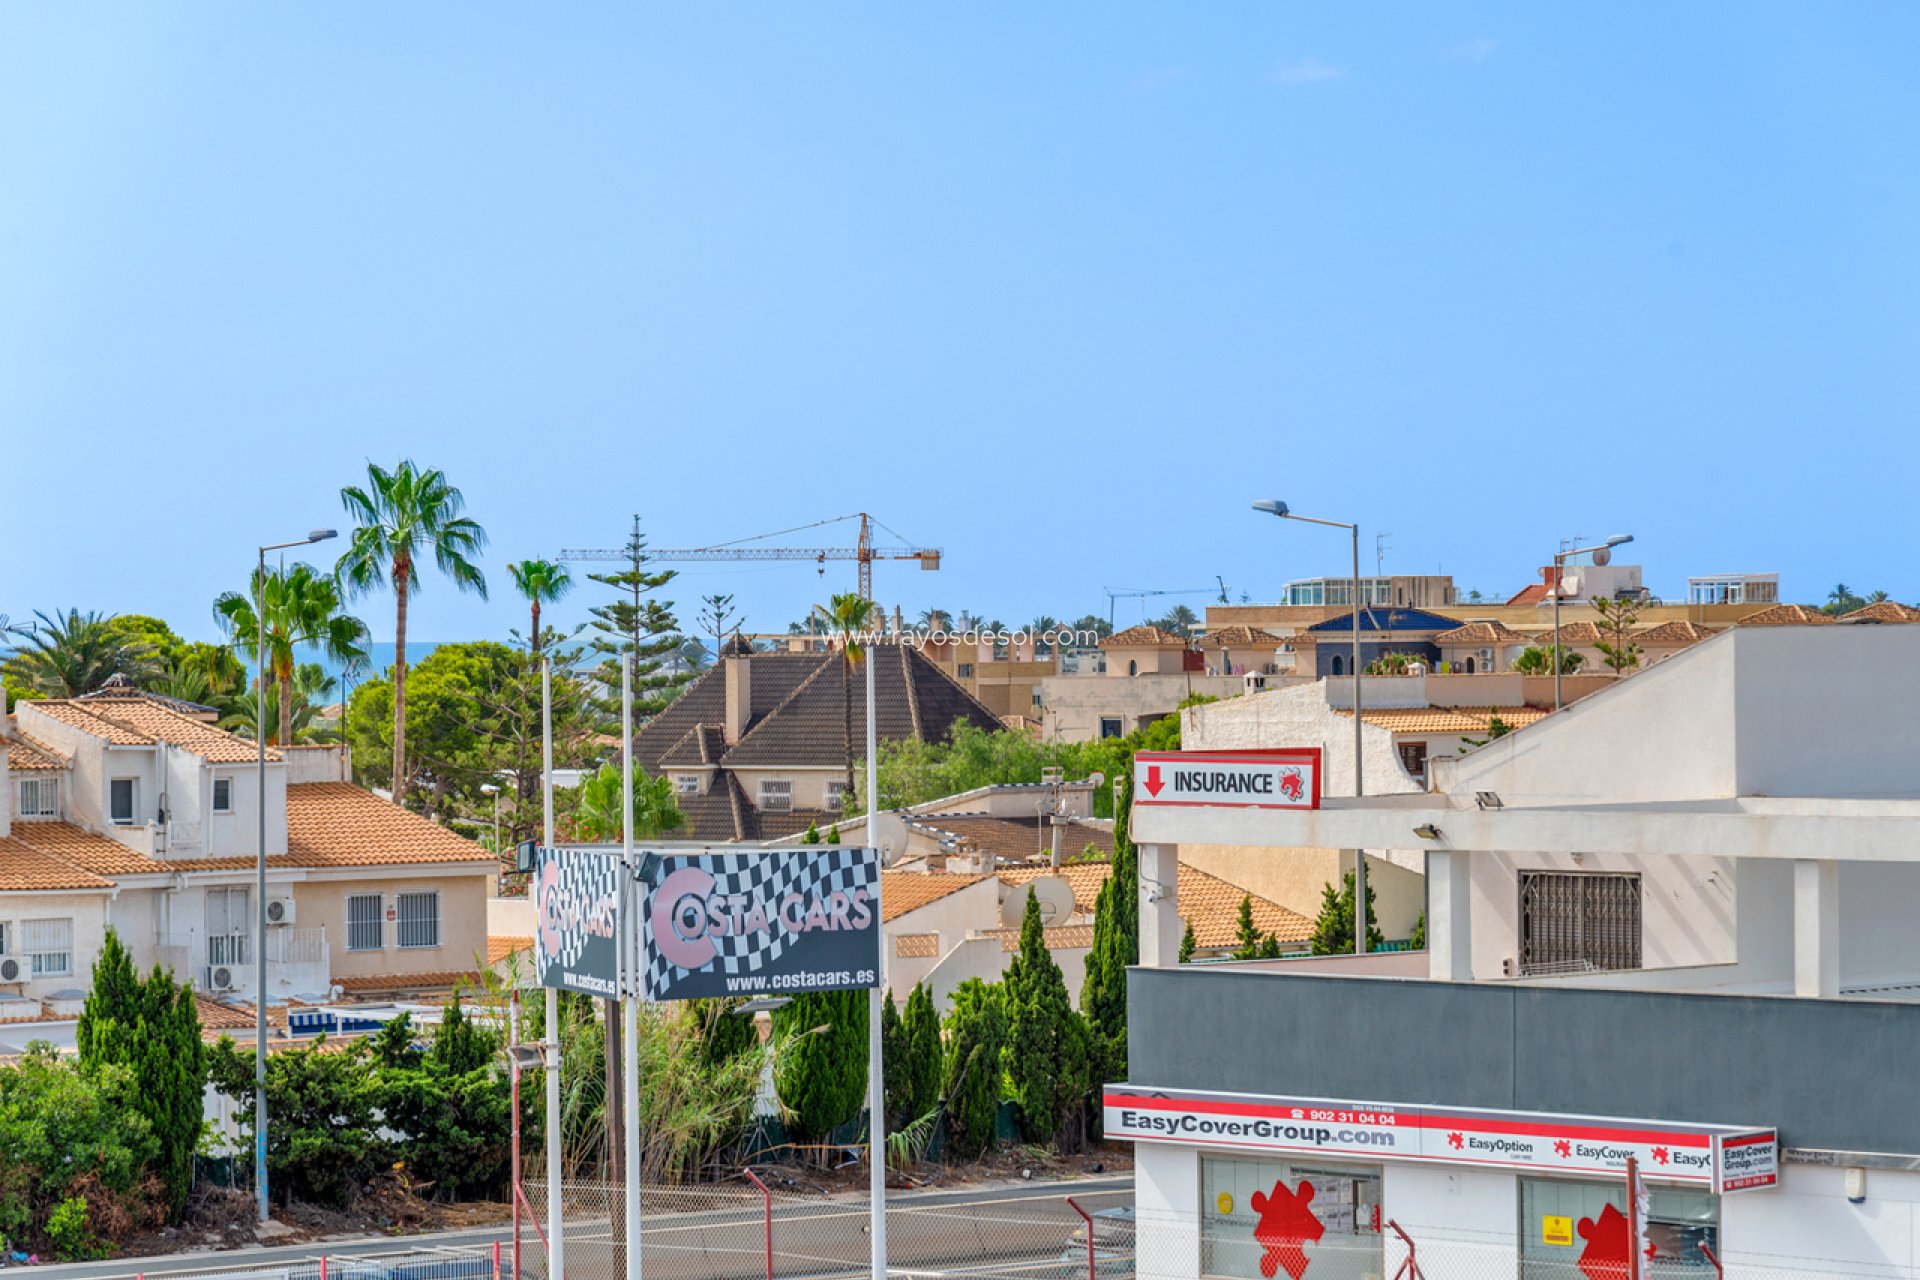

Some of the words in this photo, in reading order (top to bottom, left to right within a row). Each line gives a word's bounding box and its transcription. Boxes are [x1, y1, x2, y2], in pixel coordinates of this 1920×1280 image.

[1174, 771, 1273, 794] INSURANCE
[580, 892, 614, 940] CARS
[652, 866, 770, 969] COSTA
[780, 889, 872, 933] CARS
[726, 969, 874, 991] www.costacars.es
[1310, 1110, 1335, 1121] 902
[1338, 1112, 1353, 1122] 31
[1358, 1114, 1375, 1124] 04
[1379, 1115, 1395, 1125] 04
[1121, 1111, 1395, 1147] EasyCoverGroup.com
[1469, 1136, 1533, 1153] EasyOption
[1576, 1144, 1635, 1161] EasyCover
